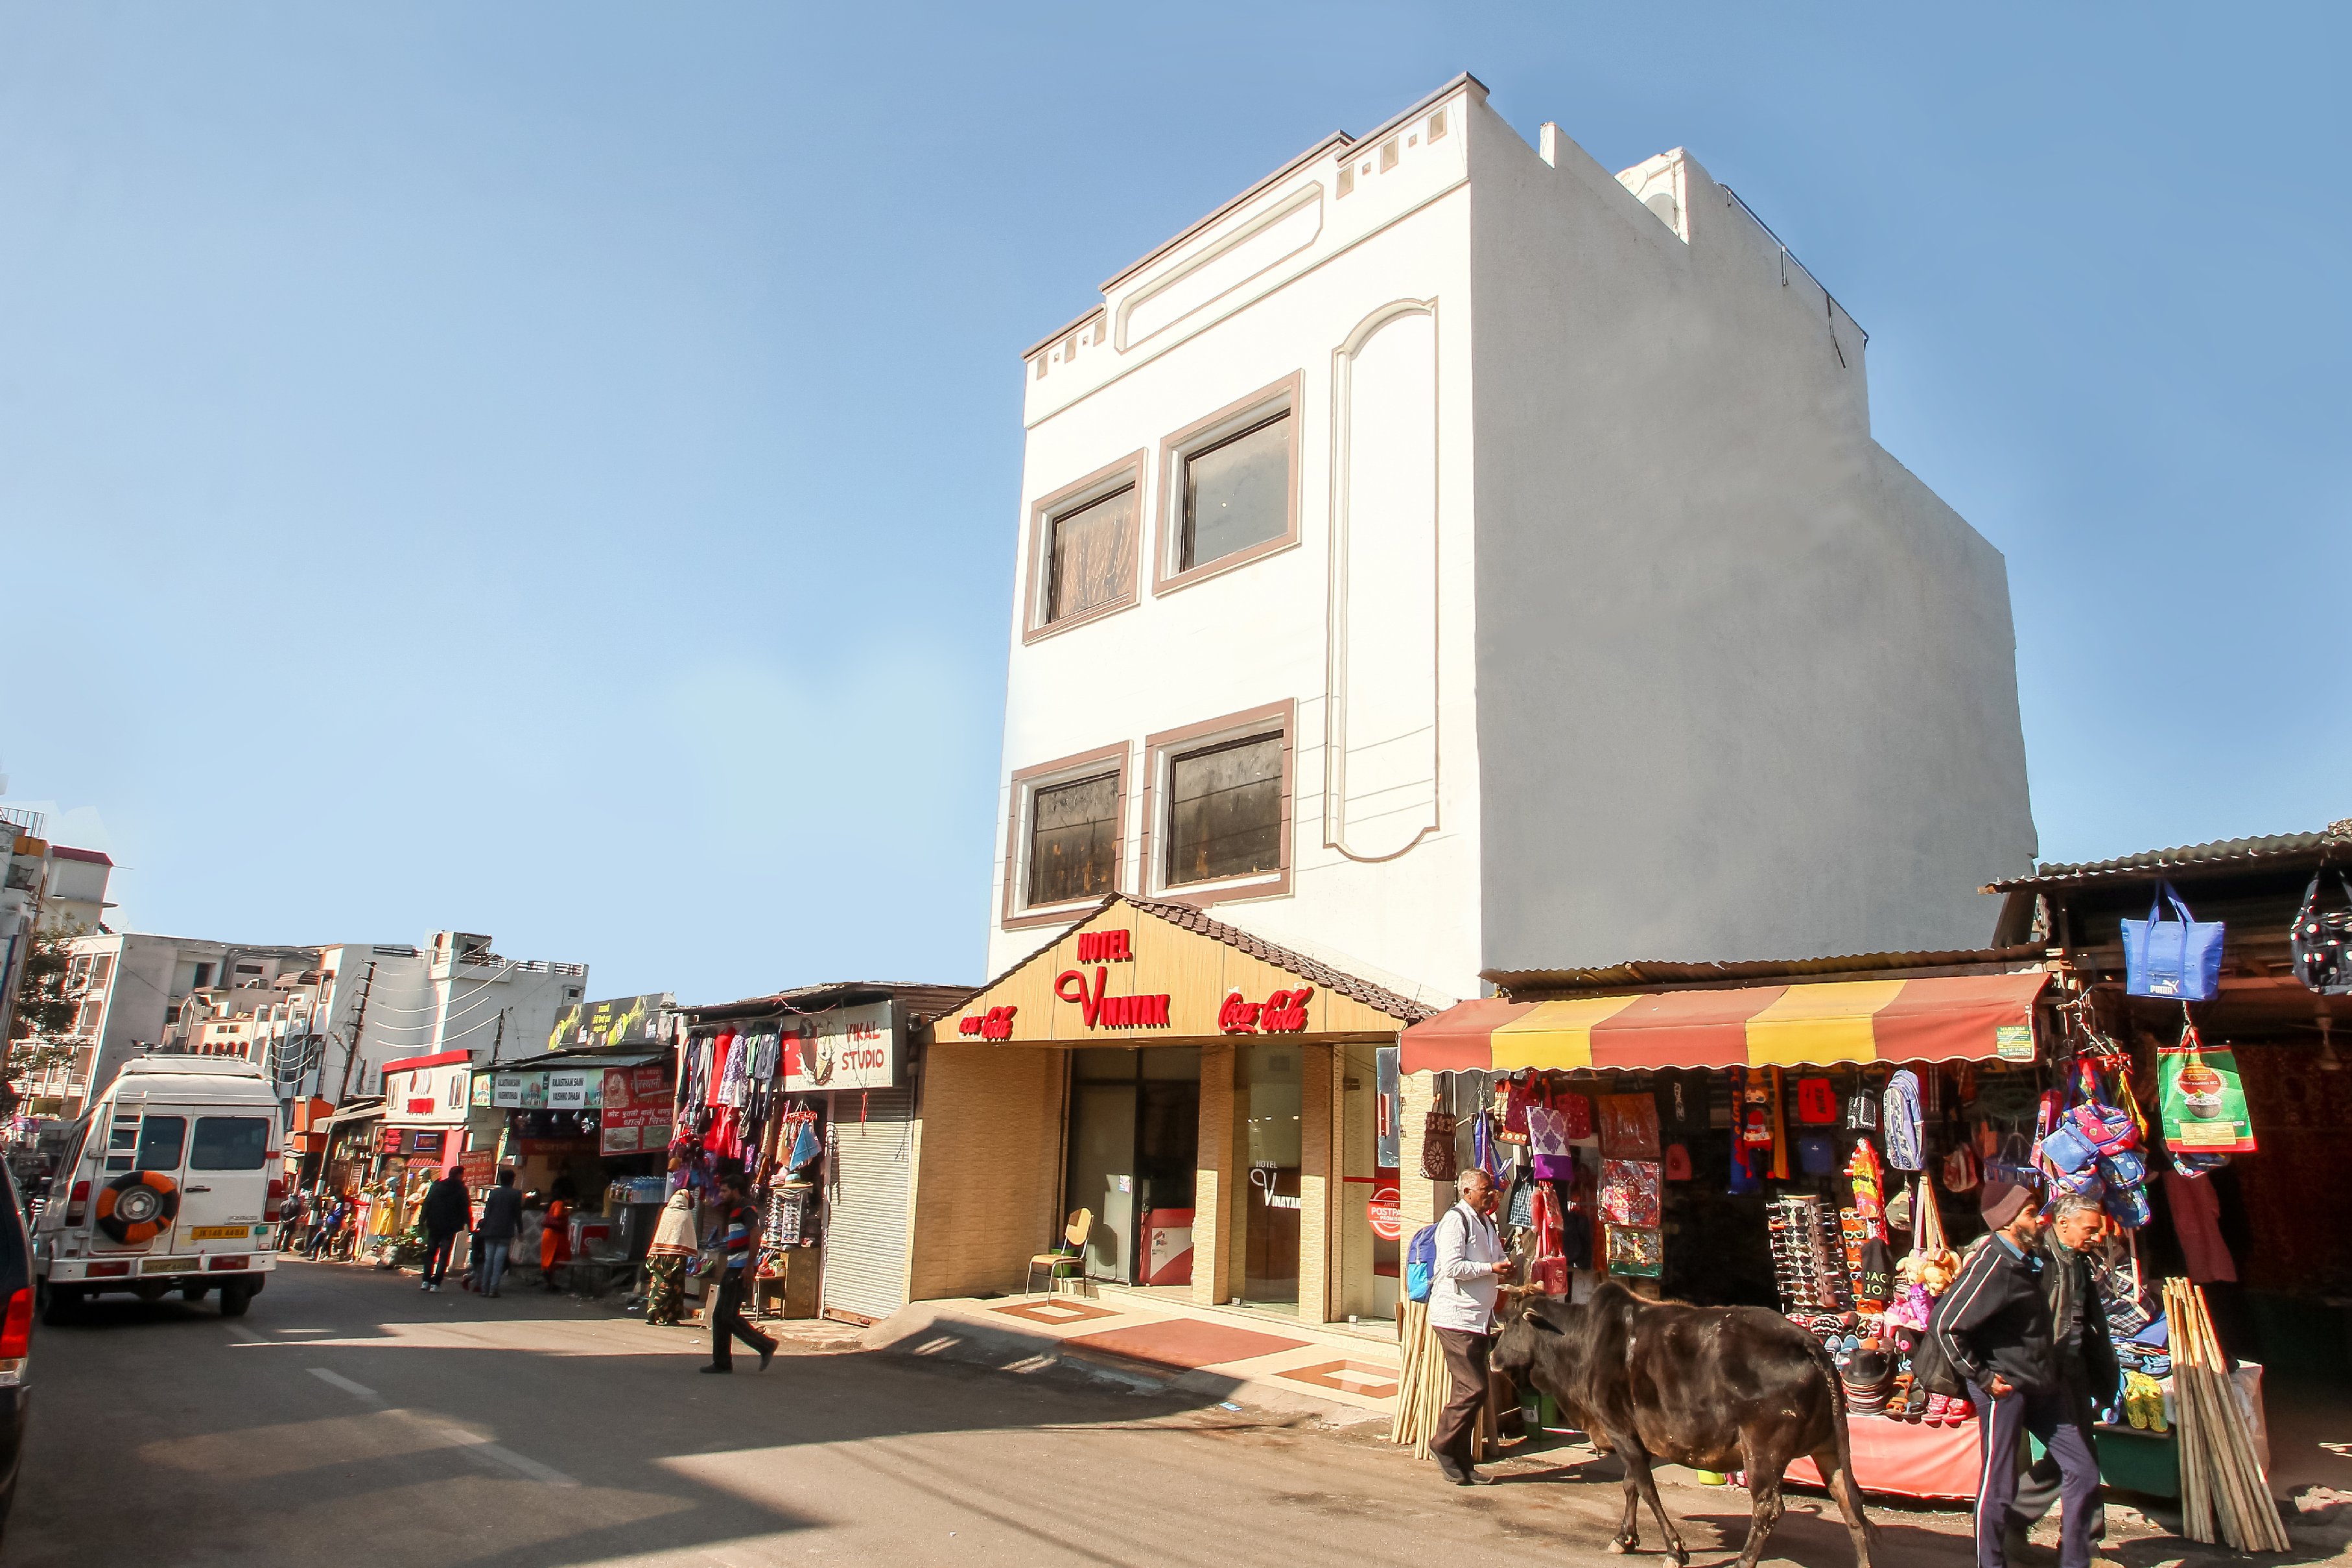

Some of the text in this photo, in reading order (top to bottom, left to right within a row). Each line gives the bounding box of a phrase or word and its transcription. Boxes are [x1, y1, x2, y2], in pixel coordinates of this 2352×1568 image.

[1077, 929, 1132, 963] HOTEL
[1054, 966, 1170, 1029] VINAYAK
[2150, 985, 2173, 994] PUMA
[1218, 987, 1314, 1033] Coca-Cola
[845, 1021, 880, 1043] VIKAL
[841, 1049, 884, 1071] STUDIO
[1256, 1160, 1277, 1169] HOTEL
[1370, 1206, 1401, 1216] POSTPA
